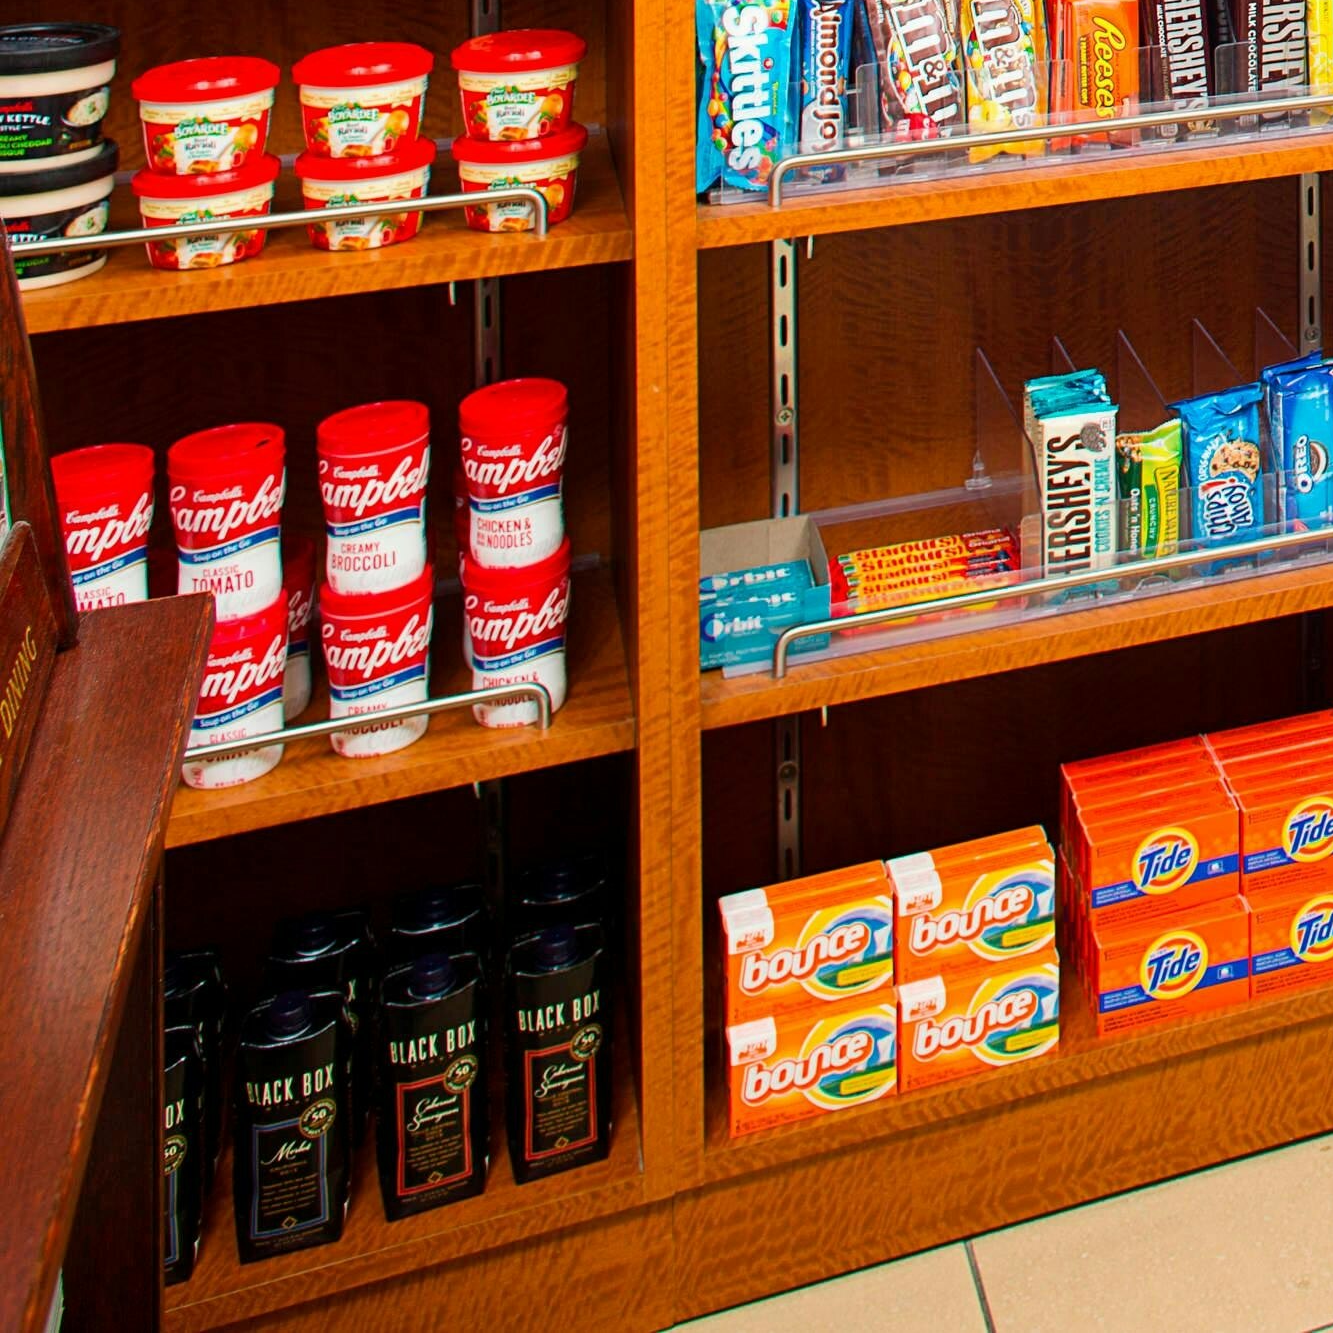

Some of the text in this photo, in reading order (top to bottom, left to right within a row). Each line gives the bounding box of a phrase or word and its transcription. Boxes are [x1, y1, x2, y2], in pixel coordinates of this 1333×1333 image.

[1248, 3, 1257, 27] MILK
[723, 6, 771, 170] Skittles
[174, 124, 228, 136] BOYARDEE
[1162, 469, 1177, 515] NATURE
[477, 518, 522, 532] CHICKEN
[1095, 509, 1111, 553] COOKIES
[1130, 488, 1139, 555] Oats Honey
[1148, 497, 1156, 539] CRUNCHY
[1204, 491, 1235, 536] Chips
[331, 551, 398, 572] BROCCOLI
[341, 542, 380, 555] CREAMY
[487, 531, 533, 550] NOODLES
[192, 572, 254, 594] TOMATO
[202, 565, 240, 578] CLASSIC
[1138, 846, 1192, 889] Tide
[912, 886, 1031, 951] bounce
[742, 923, 869, 990] bounce
[247, 1063, 335, 1106] BLACK BOX
